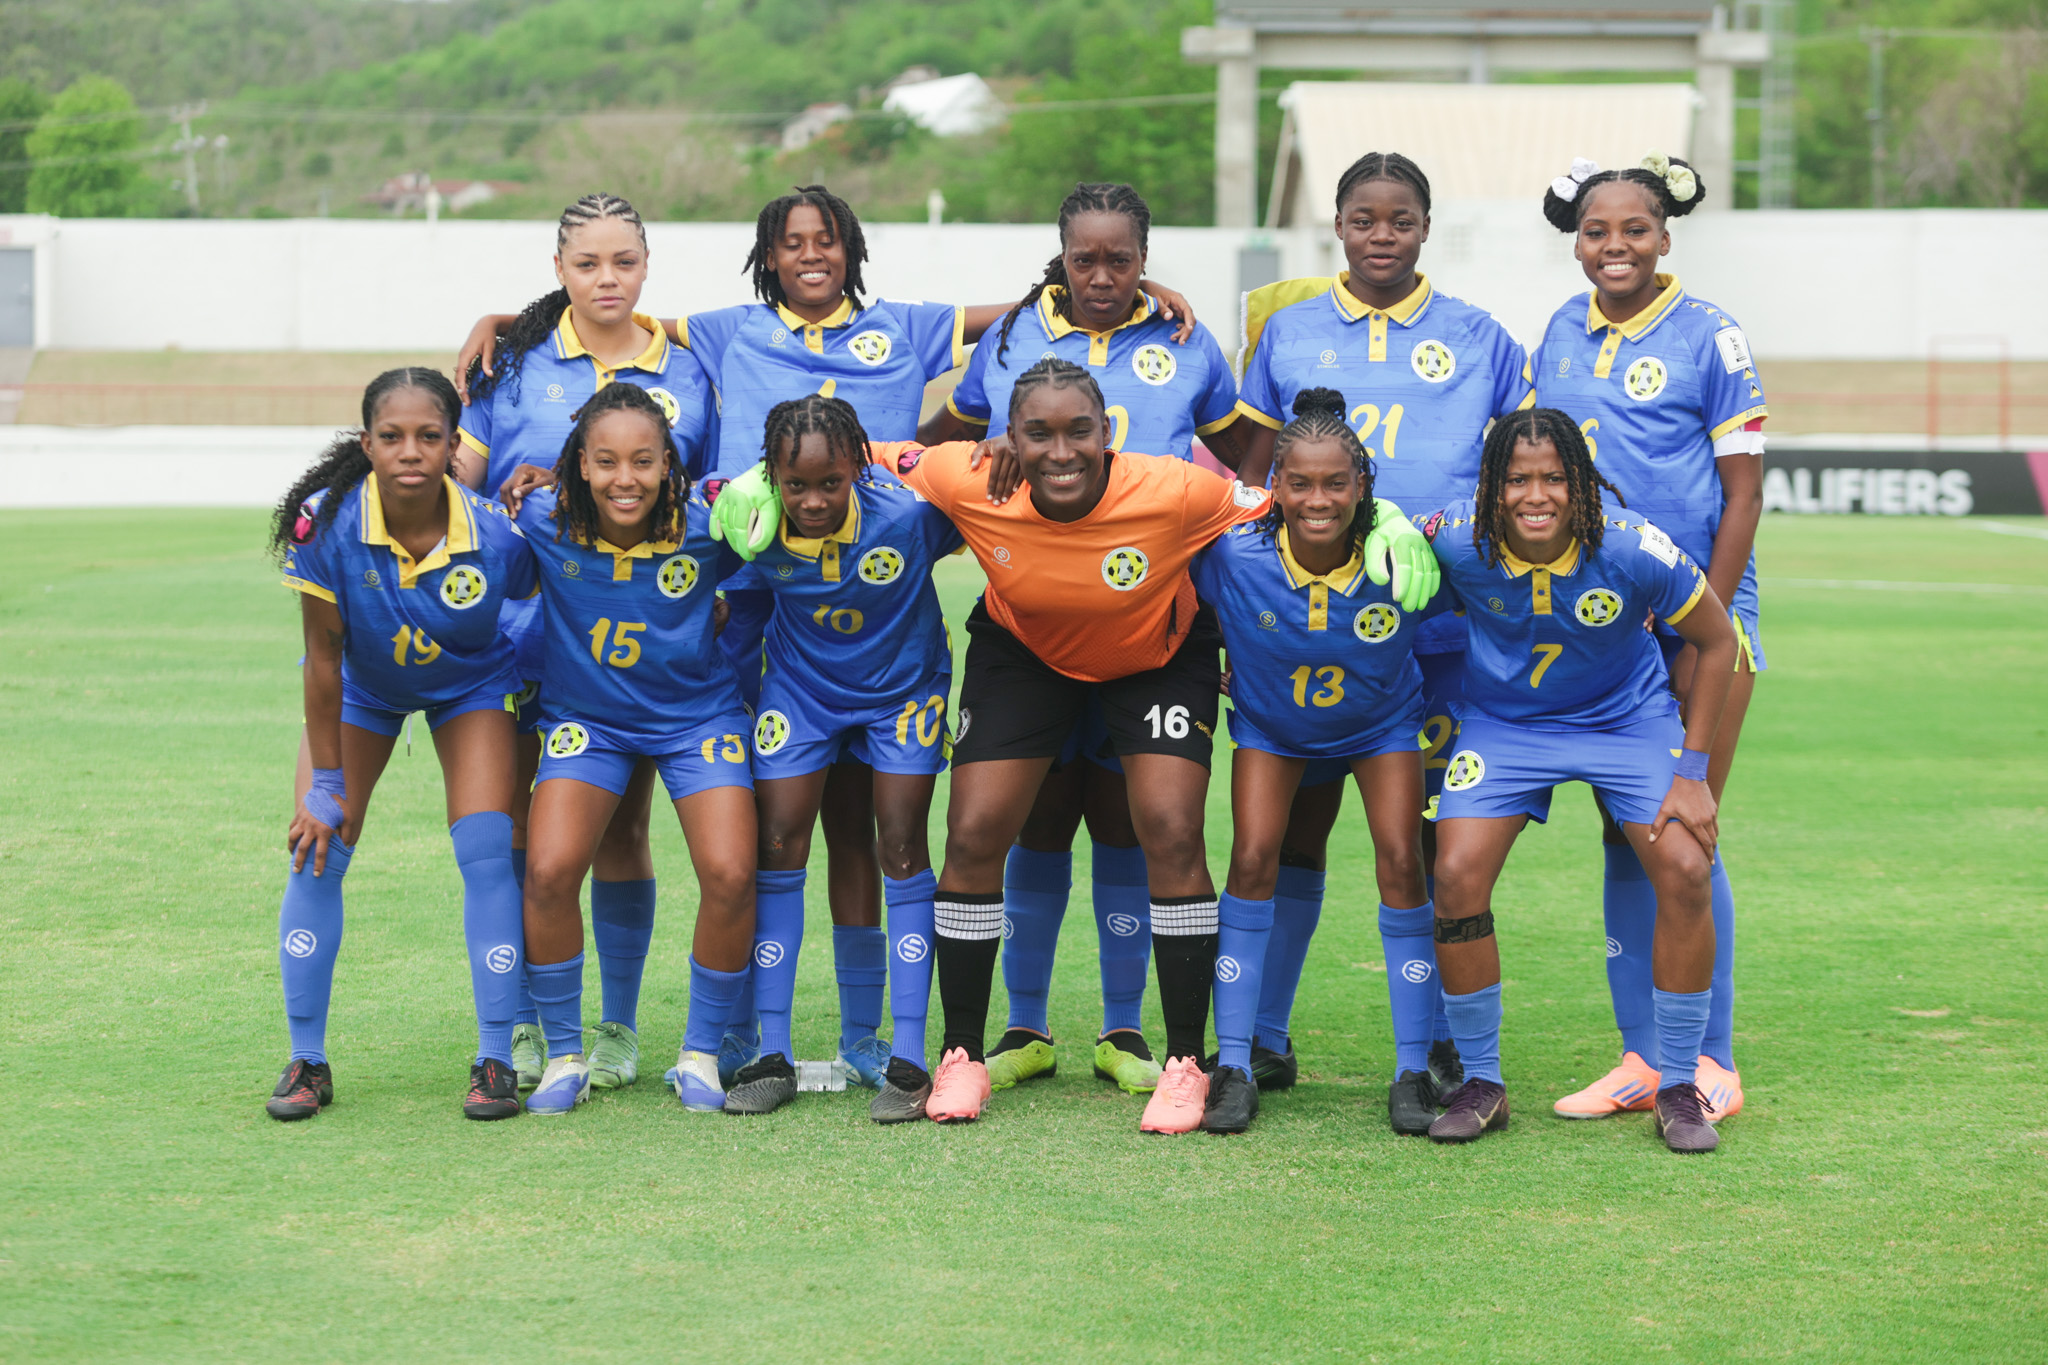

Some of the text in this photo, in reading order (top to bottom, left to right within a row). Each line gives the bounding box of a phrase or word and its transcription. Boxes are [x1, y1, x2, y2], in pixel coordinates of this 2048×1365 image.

[1350, 404, 1404, 459] 21
[813, 604, 864, 634] 10
[1257, 624, 1279, 632] STIMULUS
[391, 624, 441, 666] 19
[588, 617, 647, 668] 15
[1289, 665, 1345, 708] 13
[1530, 644, 1563, 688] 7
[896, 695, 945, 747] 10
[1144, 704, 1190, 739] 16
[1425, 715, 1460, 769] 2
